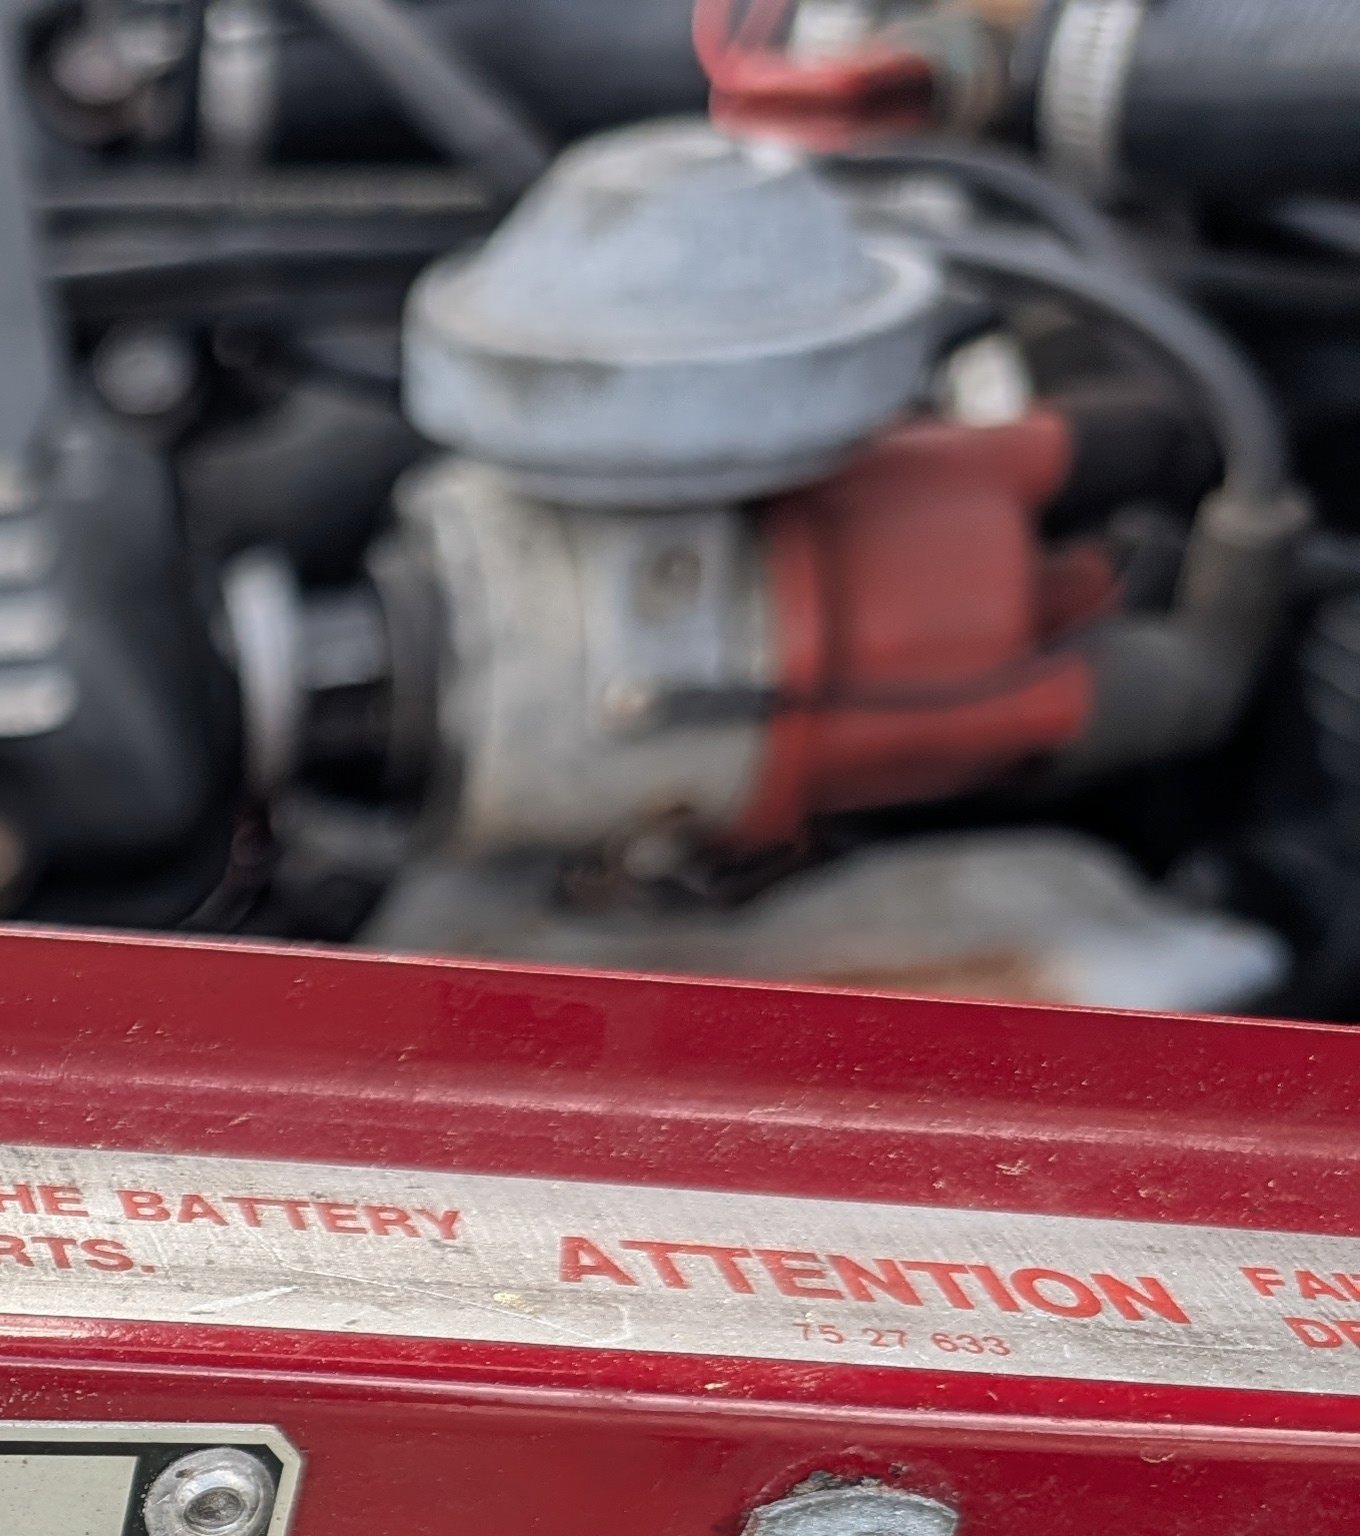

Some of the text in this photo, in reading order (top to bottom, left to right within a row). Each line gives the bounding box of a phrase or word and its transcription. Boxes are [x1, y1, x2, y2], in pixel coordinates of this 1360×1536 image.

[121, 1189, 461, 1242] BATTERY
[562, 1237, 1190, 1324] ATTENTION
[799, 1323, 1011, 1357] 75 27 633
